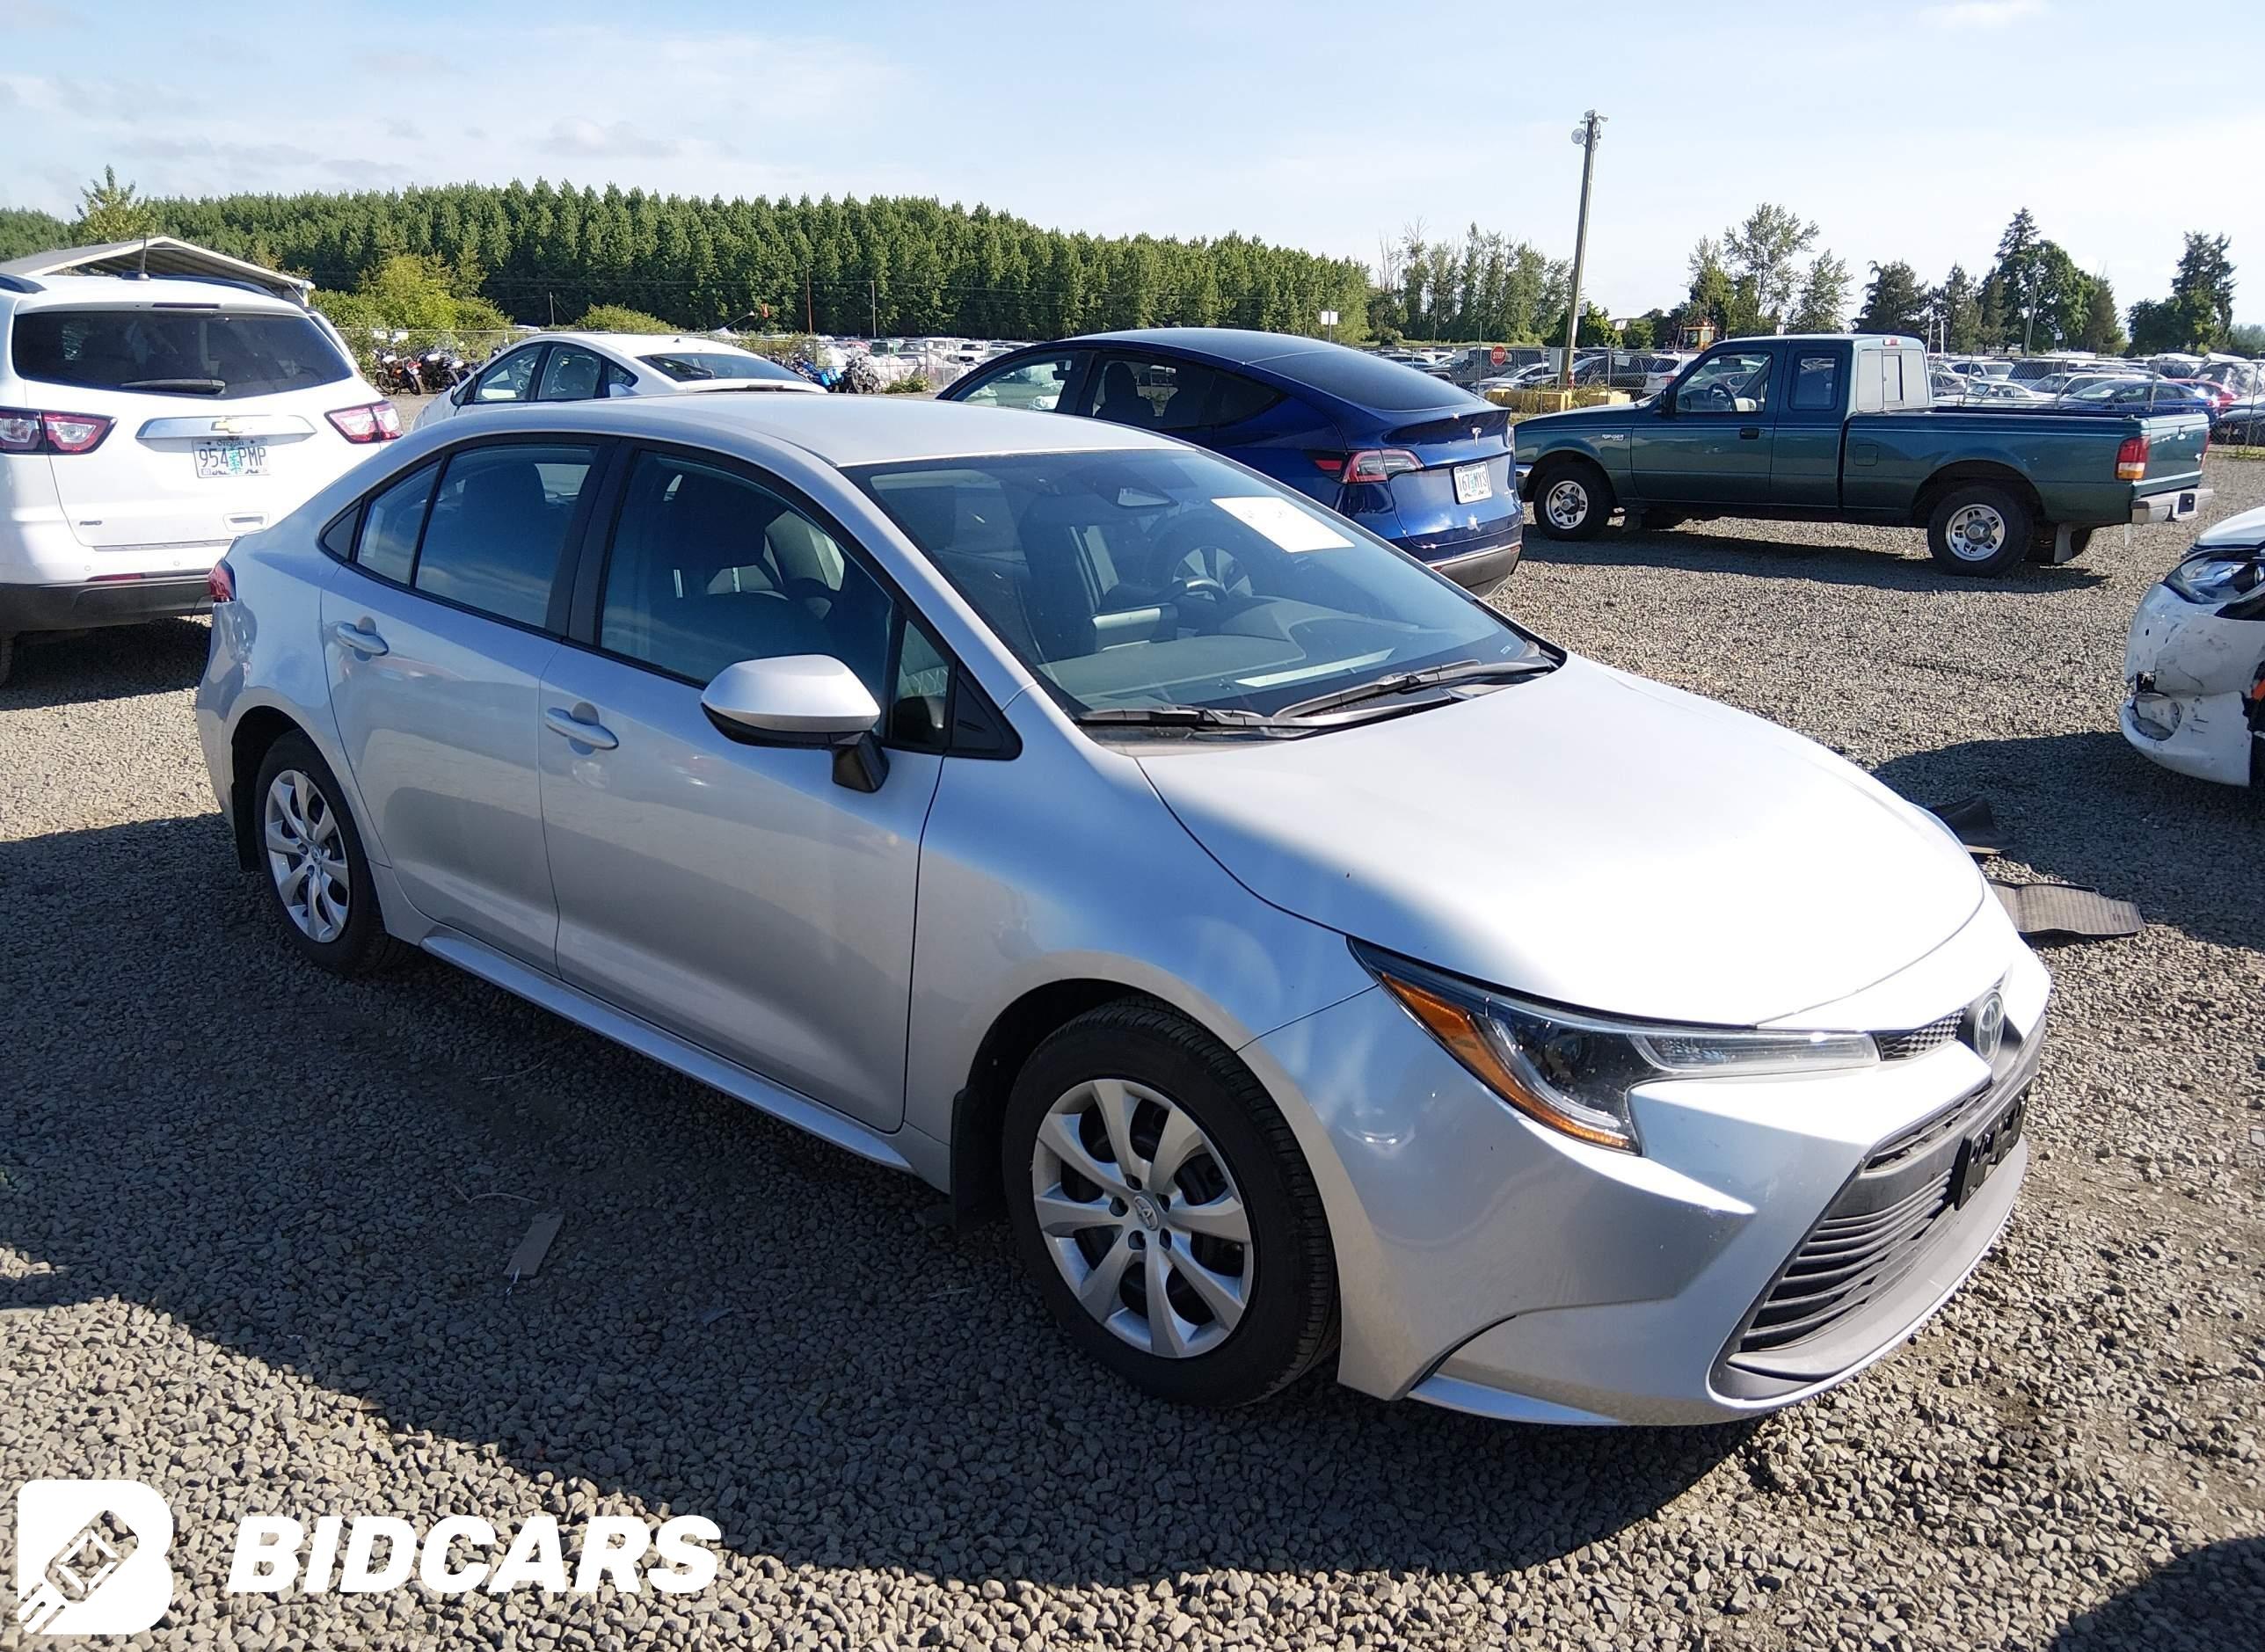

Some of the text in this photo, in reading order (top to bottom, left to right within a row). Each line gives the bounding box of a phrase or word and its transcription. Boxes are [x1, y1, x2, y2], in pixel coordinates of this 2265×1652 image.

[1492, 351, 1505, 360] STOP
[199, 447, 266, 468] 954 PMP
[1457, 473, 1472, 492] 167
